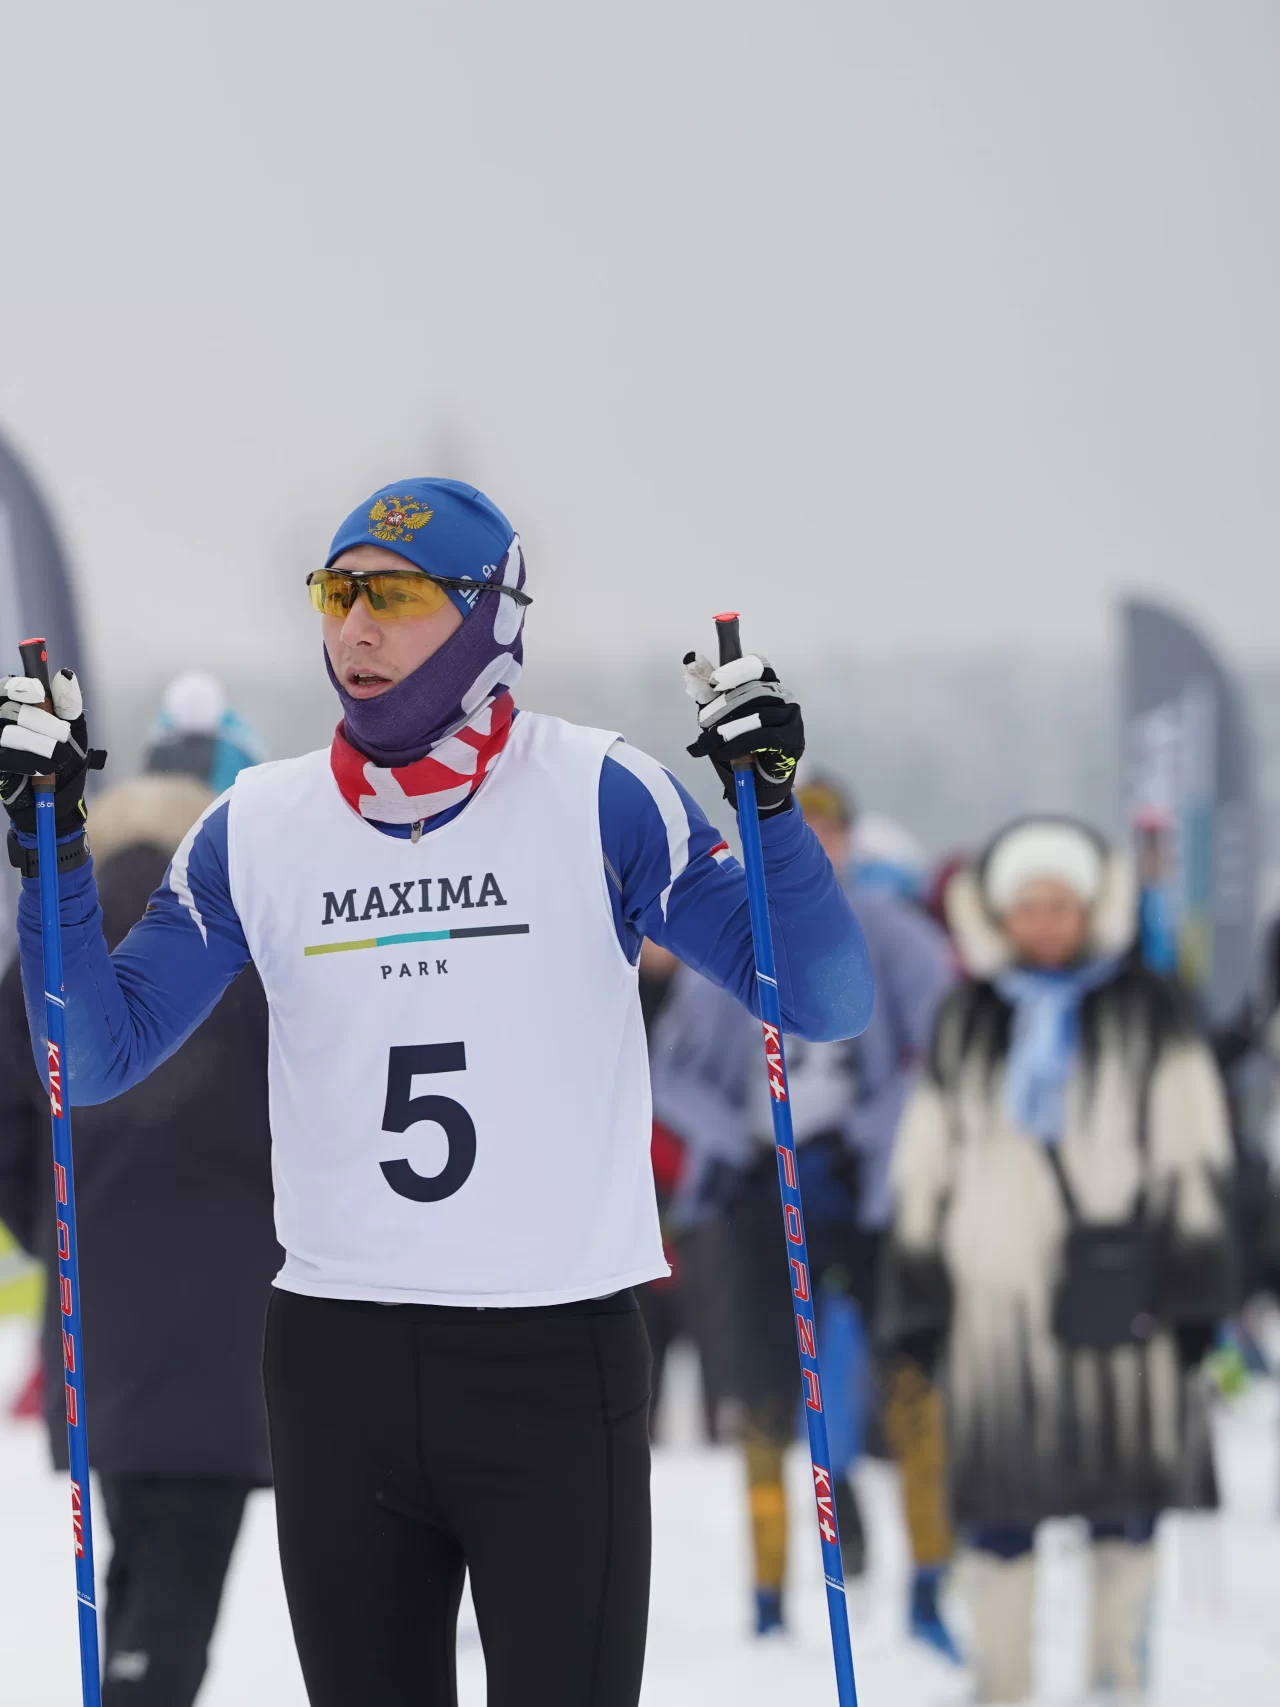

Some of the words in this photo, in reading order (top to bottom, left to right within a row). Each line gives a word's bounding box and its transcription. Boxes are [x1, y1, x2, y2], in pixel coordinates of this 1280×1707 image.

[321, 872, 508, 925] MAXIMA
[380, 959, 448, 979] PARK
[379, 1041, 477, 1203] 5
